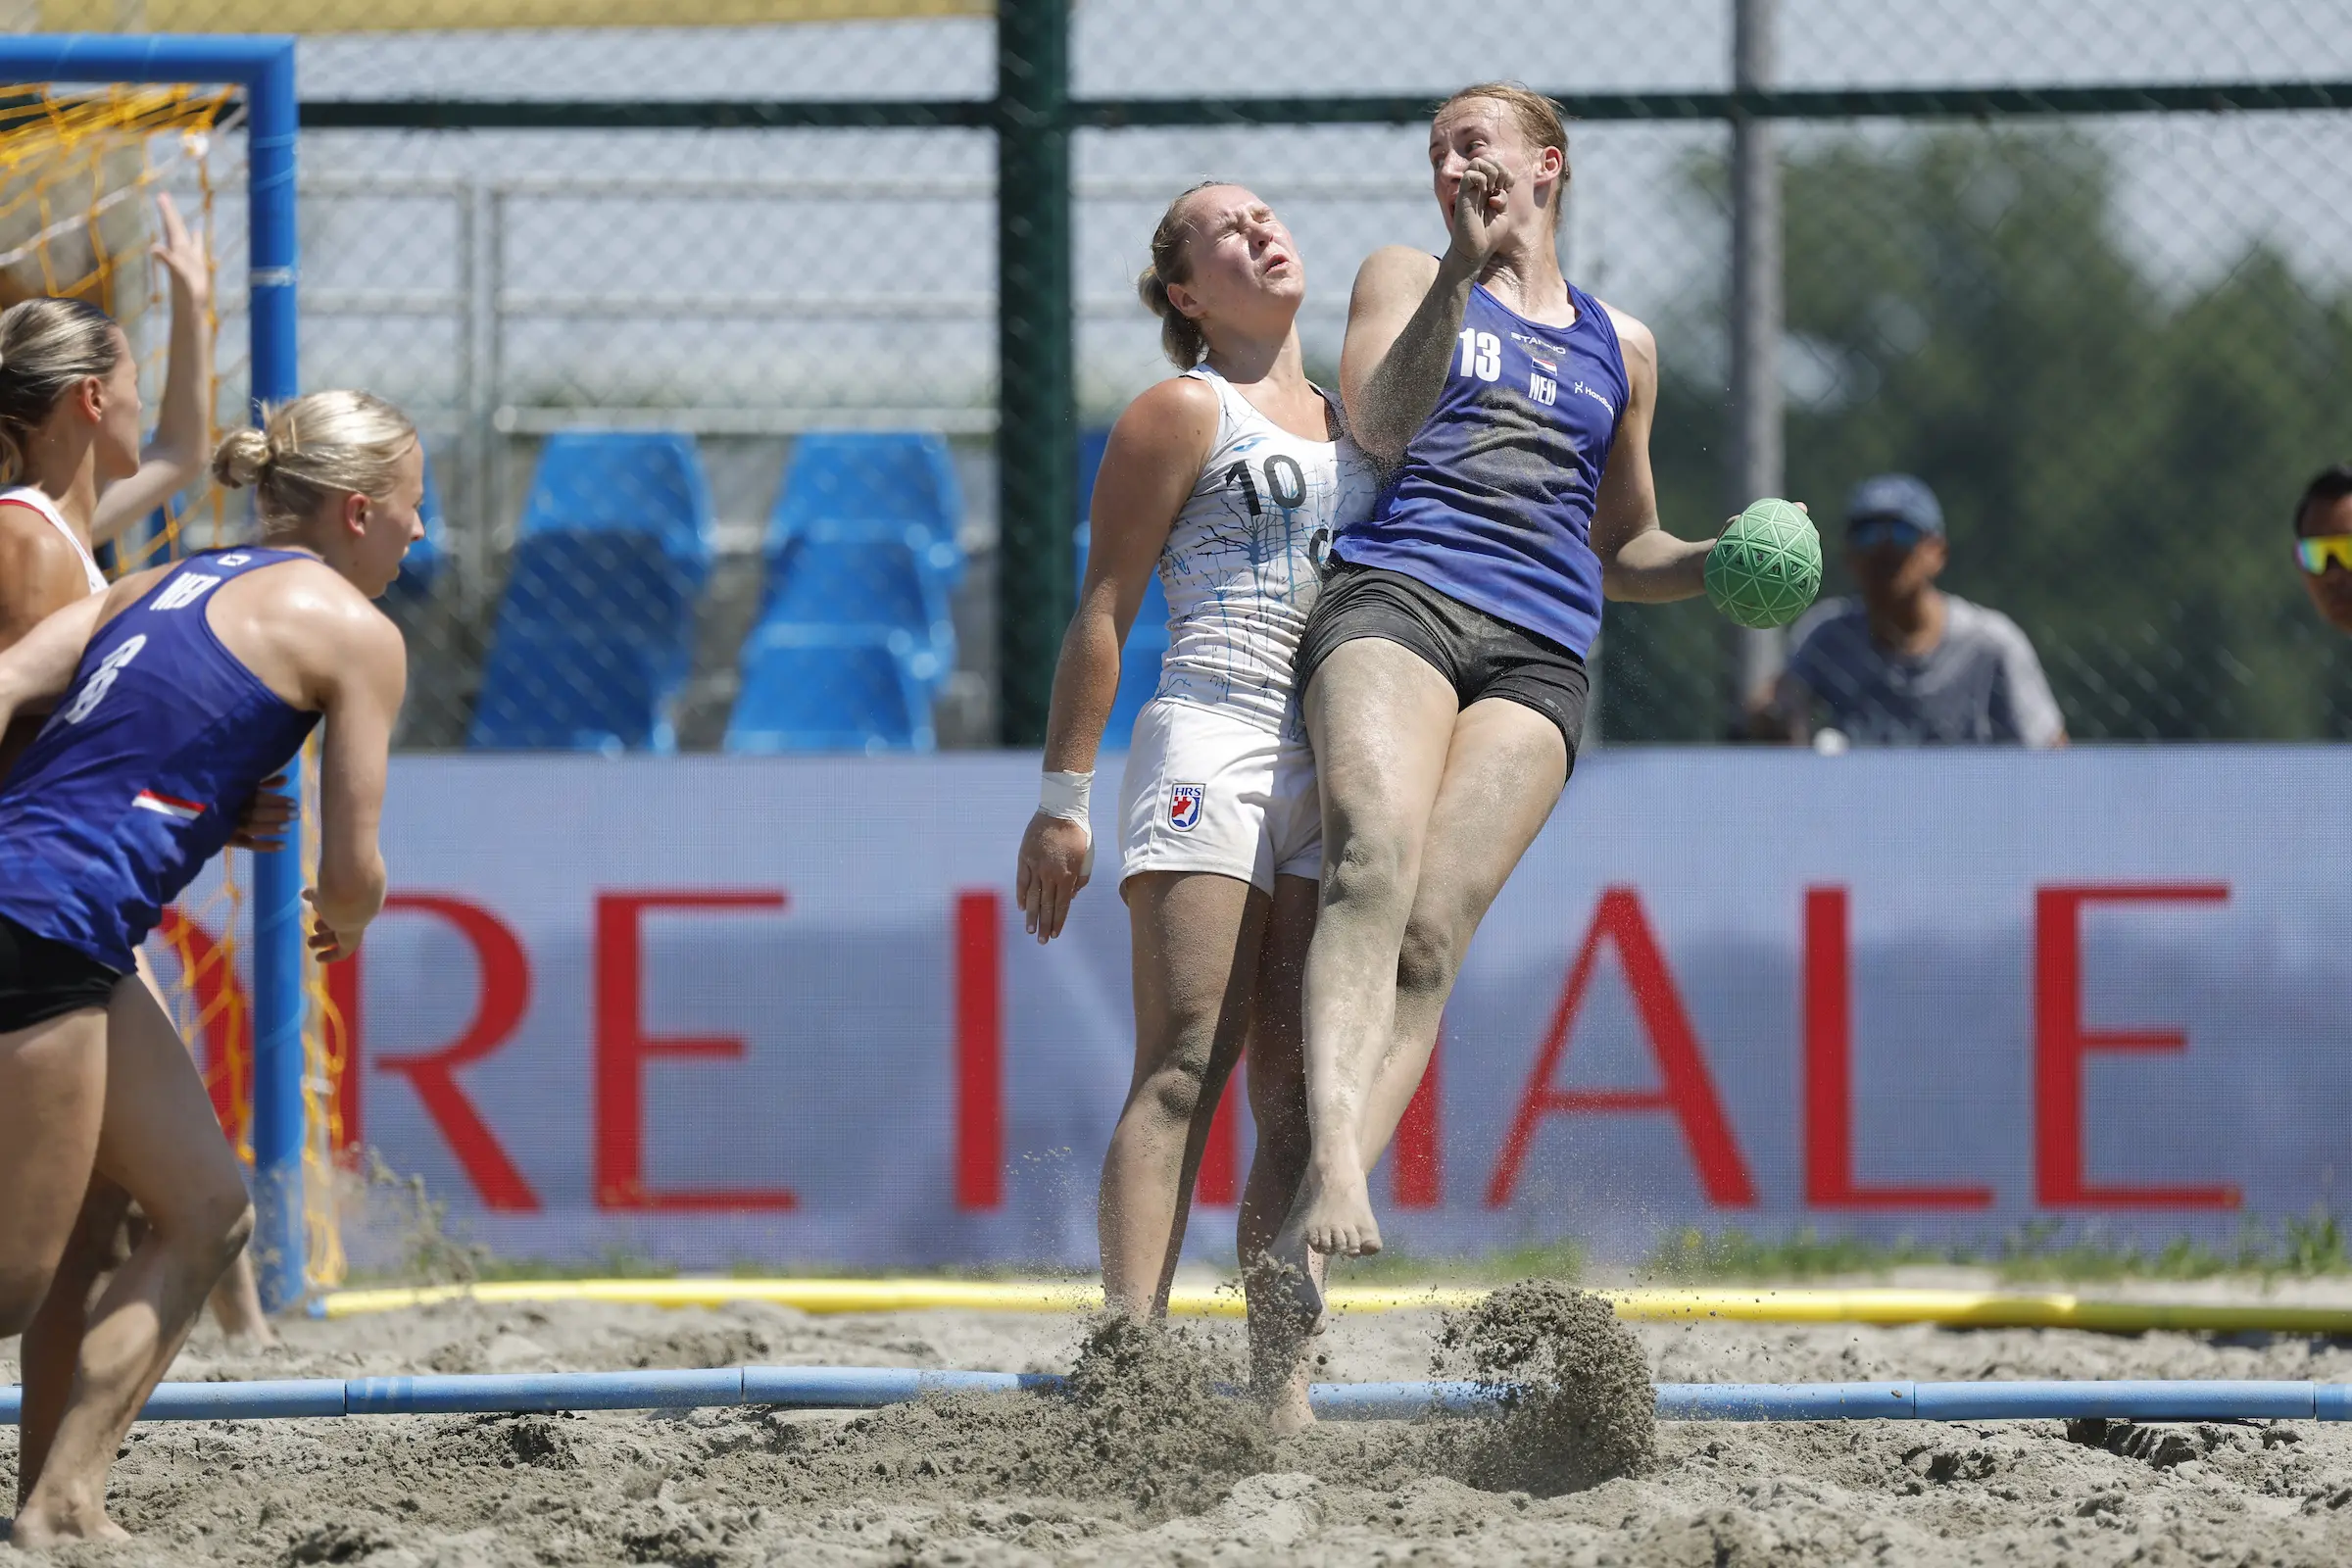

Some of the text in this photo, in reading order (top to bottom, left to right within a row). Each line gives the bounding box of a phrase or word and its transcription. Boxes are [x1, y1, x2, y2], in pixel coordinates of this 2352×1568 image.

[1459, 327, 1501, 382] 13
[1528, 372, 1557, 407] NED
[1226, 454, 1307, 516] 10
[1176, 787, 1201, 796] HRS
